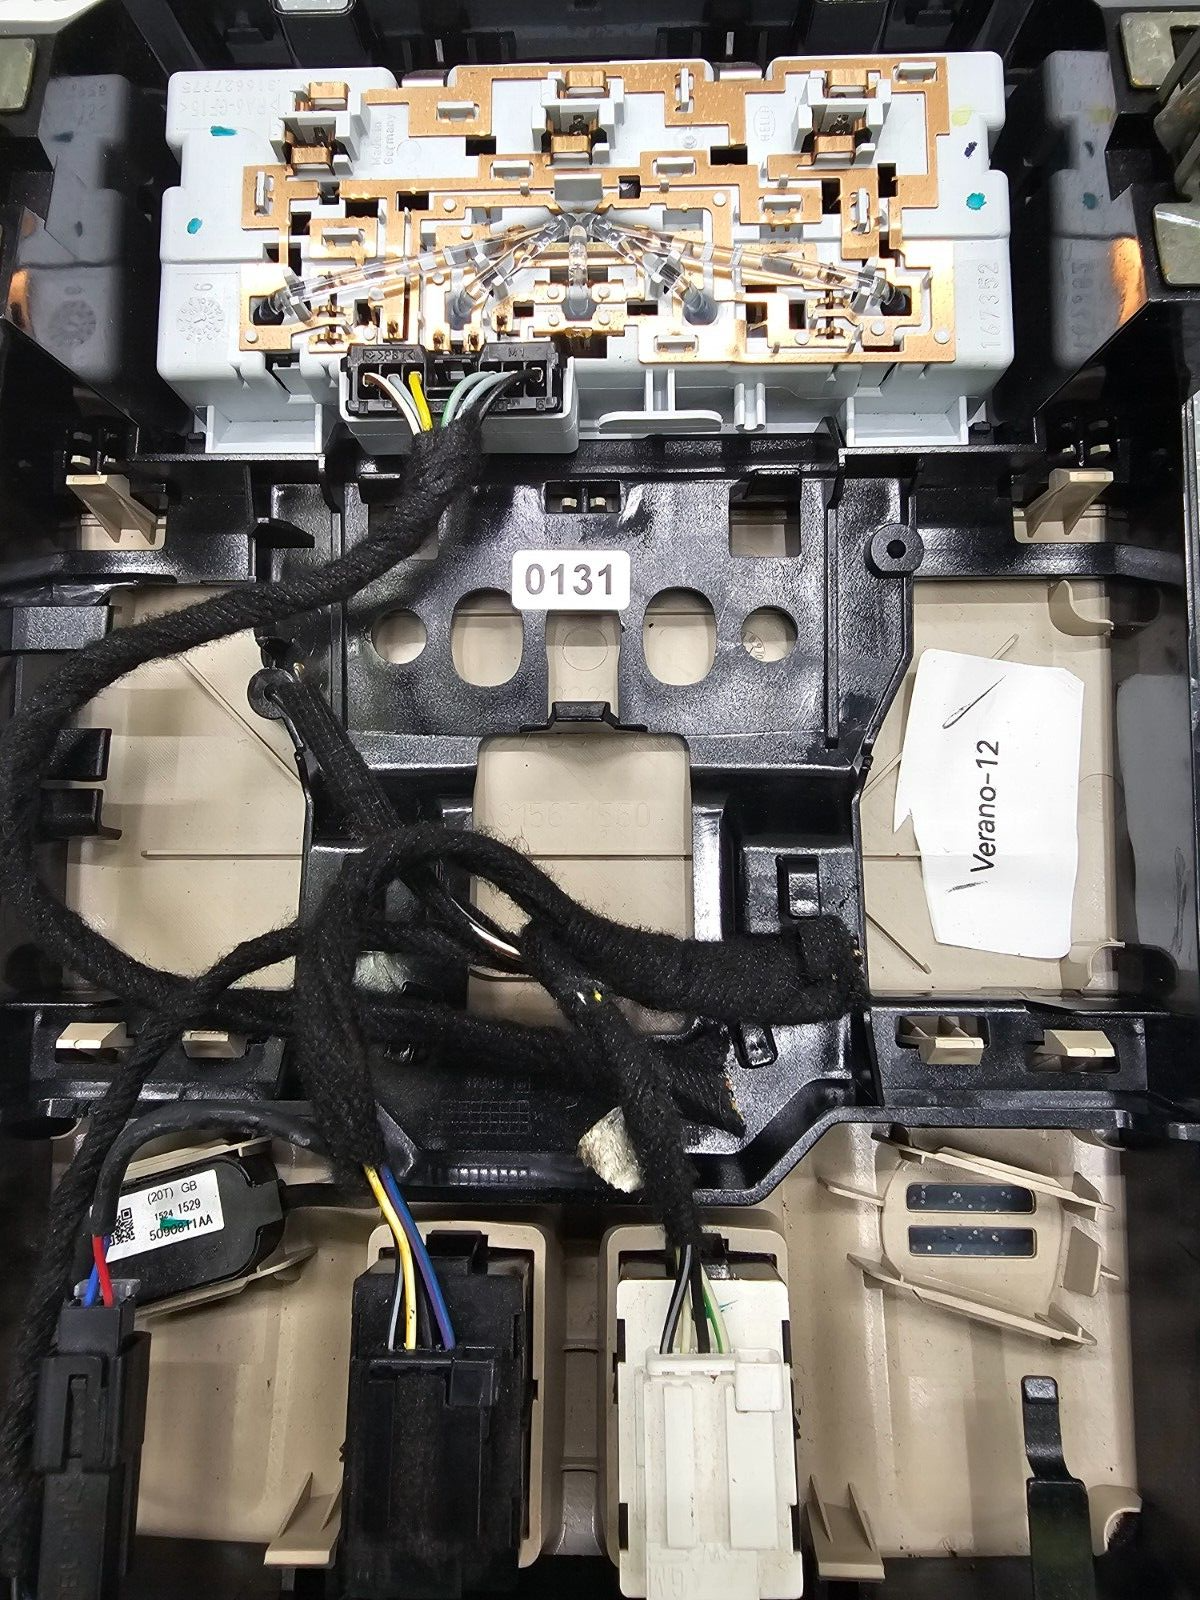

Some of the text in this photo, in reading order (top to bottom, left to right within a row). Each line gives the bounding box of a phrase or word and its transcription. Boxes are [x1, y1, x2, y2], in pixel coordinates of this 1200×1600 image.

[383, 113, 396, 165] Germany
[759, 106, 772, 142] HELLA
[978, 262, 1001, 349] 167352
[525, 563, 613, 595] 0131
[970, 740, 999, 873] Verano-12
[147, 1180, 198, 1205] (20T) GB
[154, 1198, 201, 1221] 1524 1529
